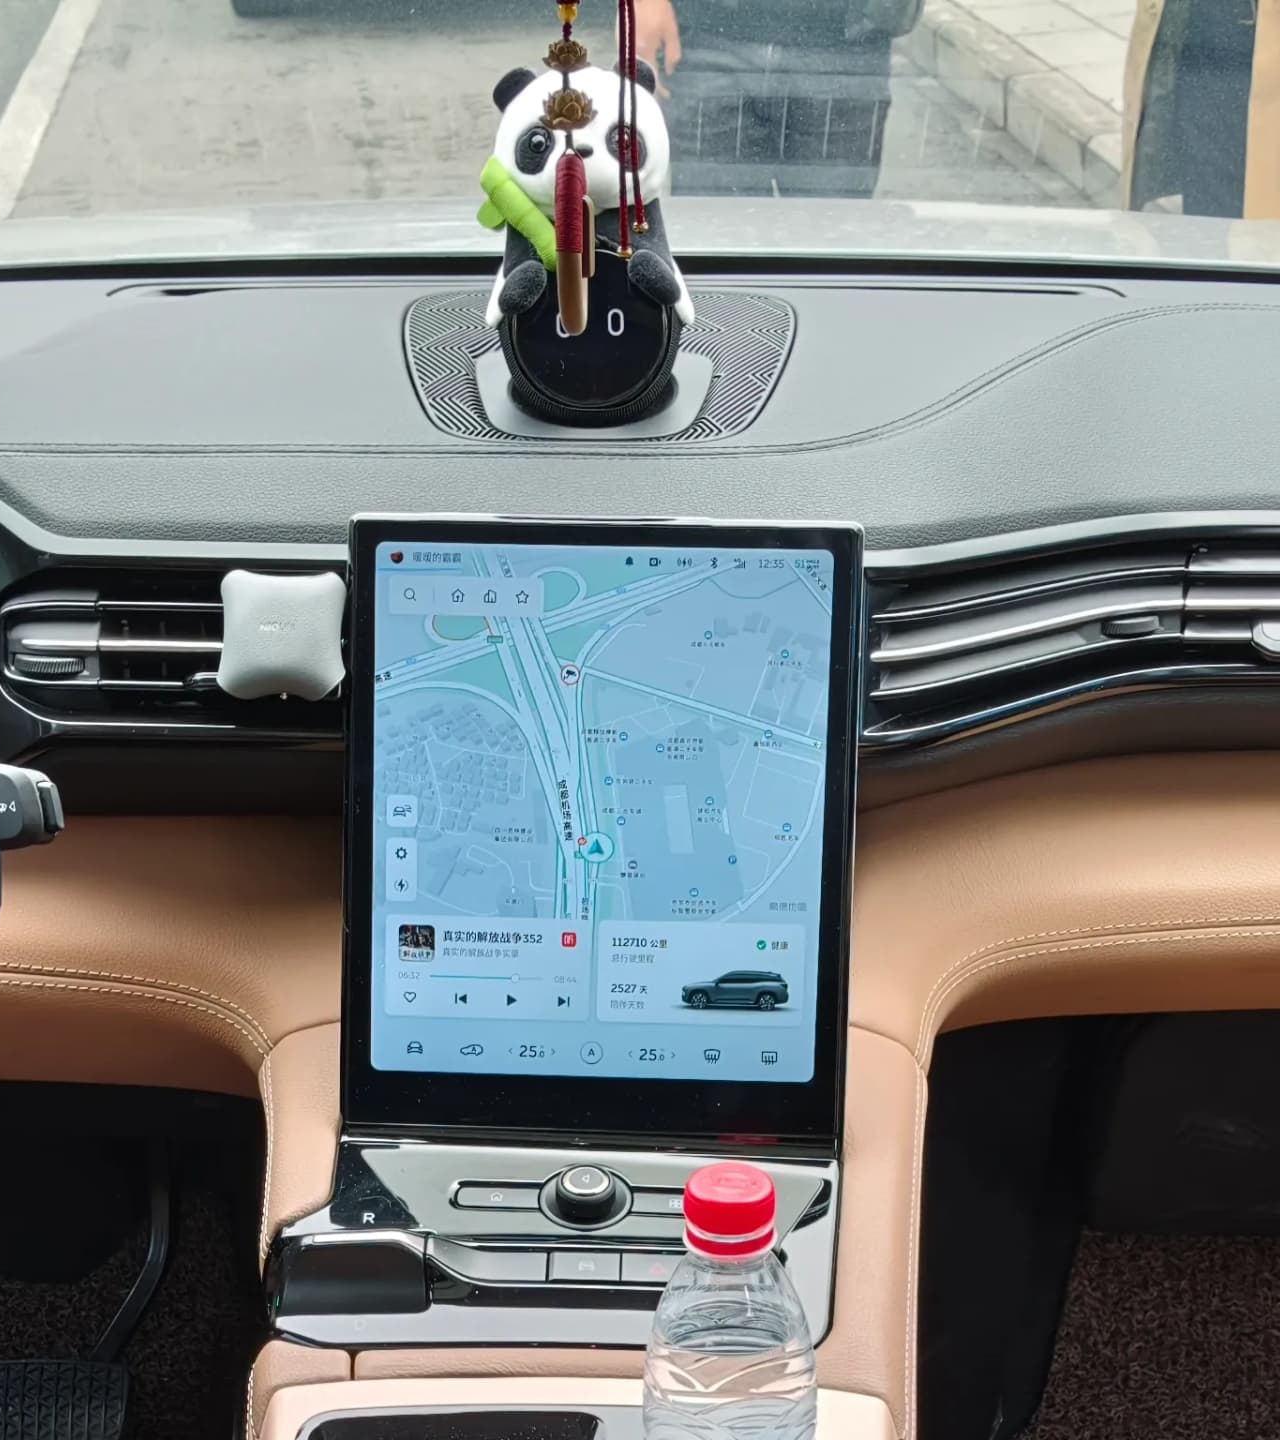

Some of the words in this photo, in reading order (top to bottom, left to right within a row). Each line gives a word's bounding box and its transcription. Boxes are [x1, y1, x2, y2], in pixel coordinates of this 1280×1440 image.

[758, 559, 785, 569] 12:35
[442, 930, 543, 944] 真实的解放战争352
[612, 937, 647, 948] 112710
[610, 984, 637, 994] 2527
[362, 1212, 376, 1224] R
